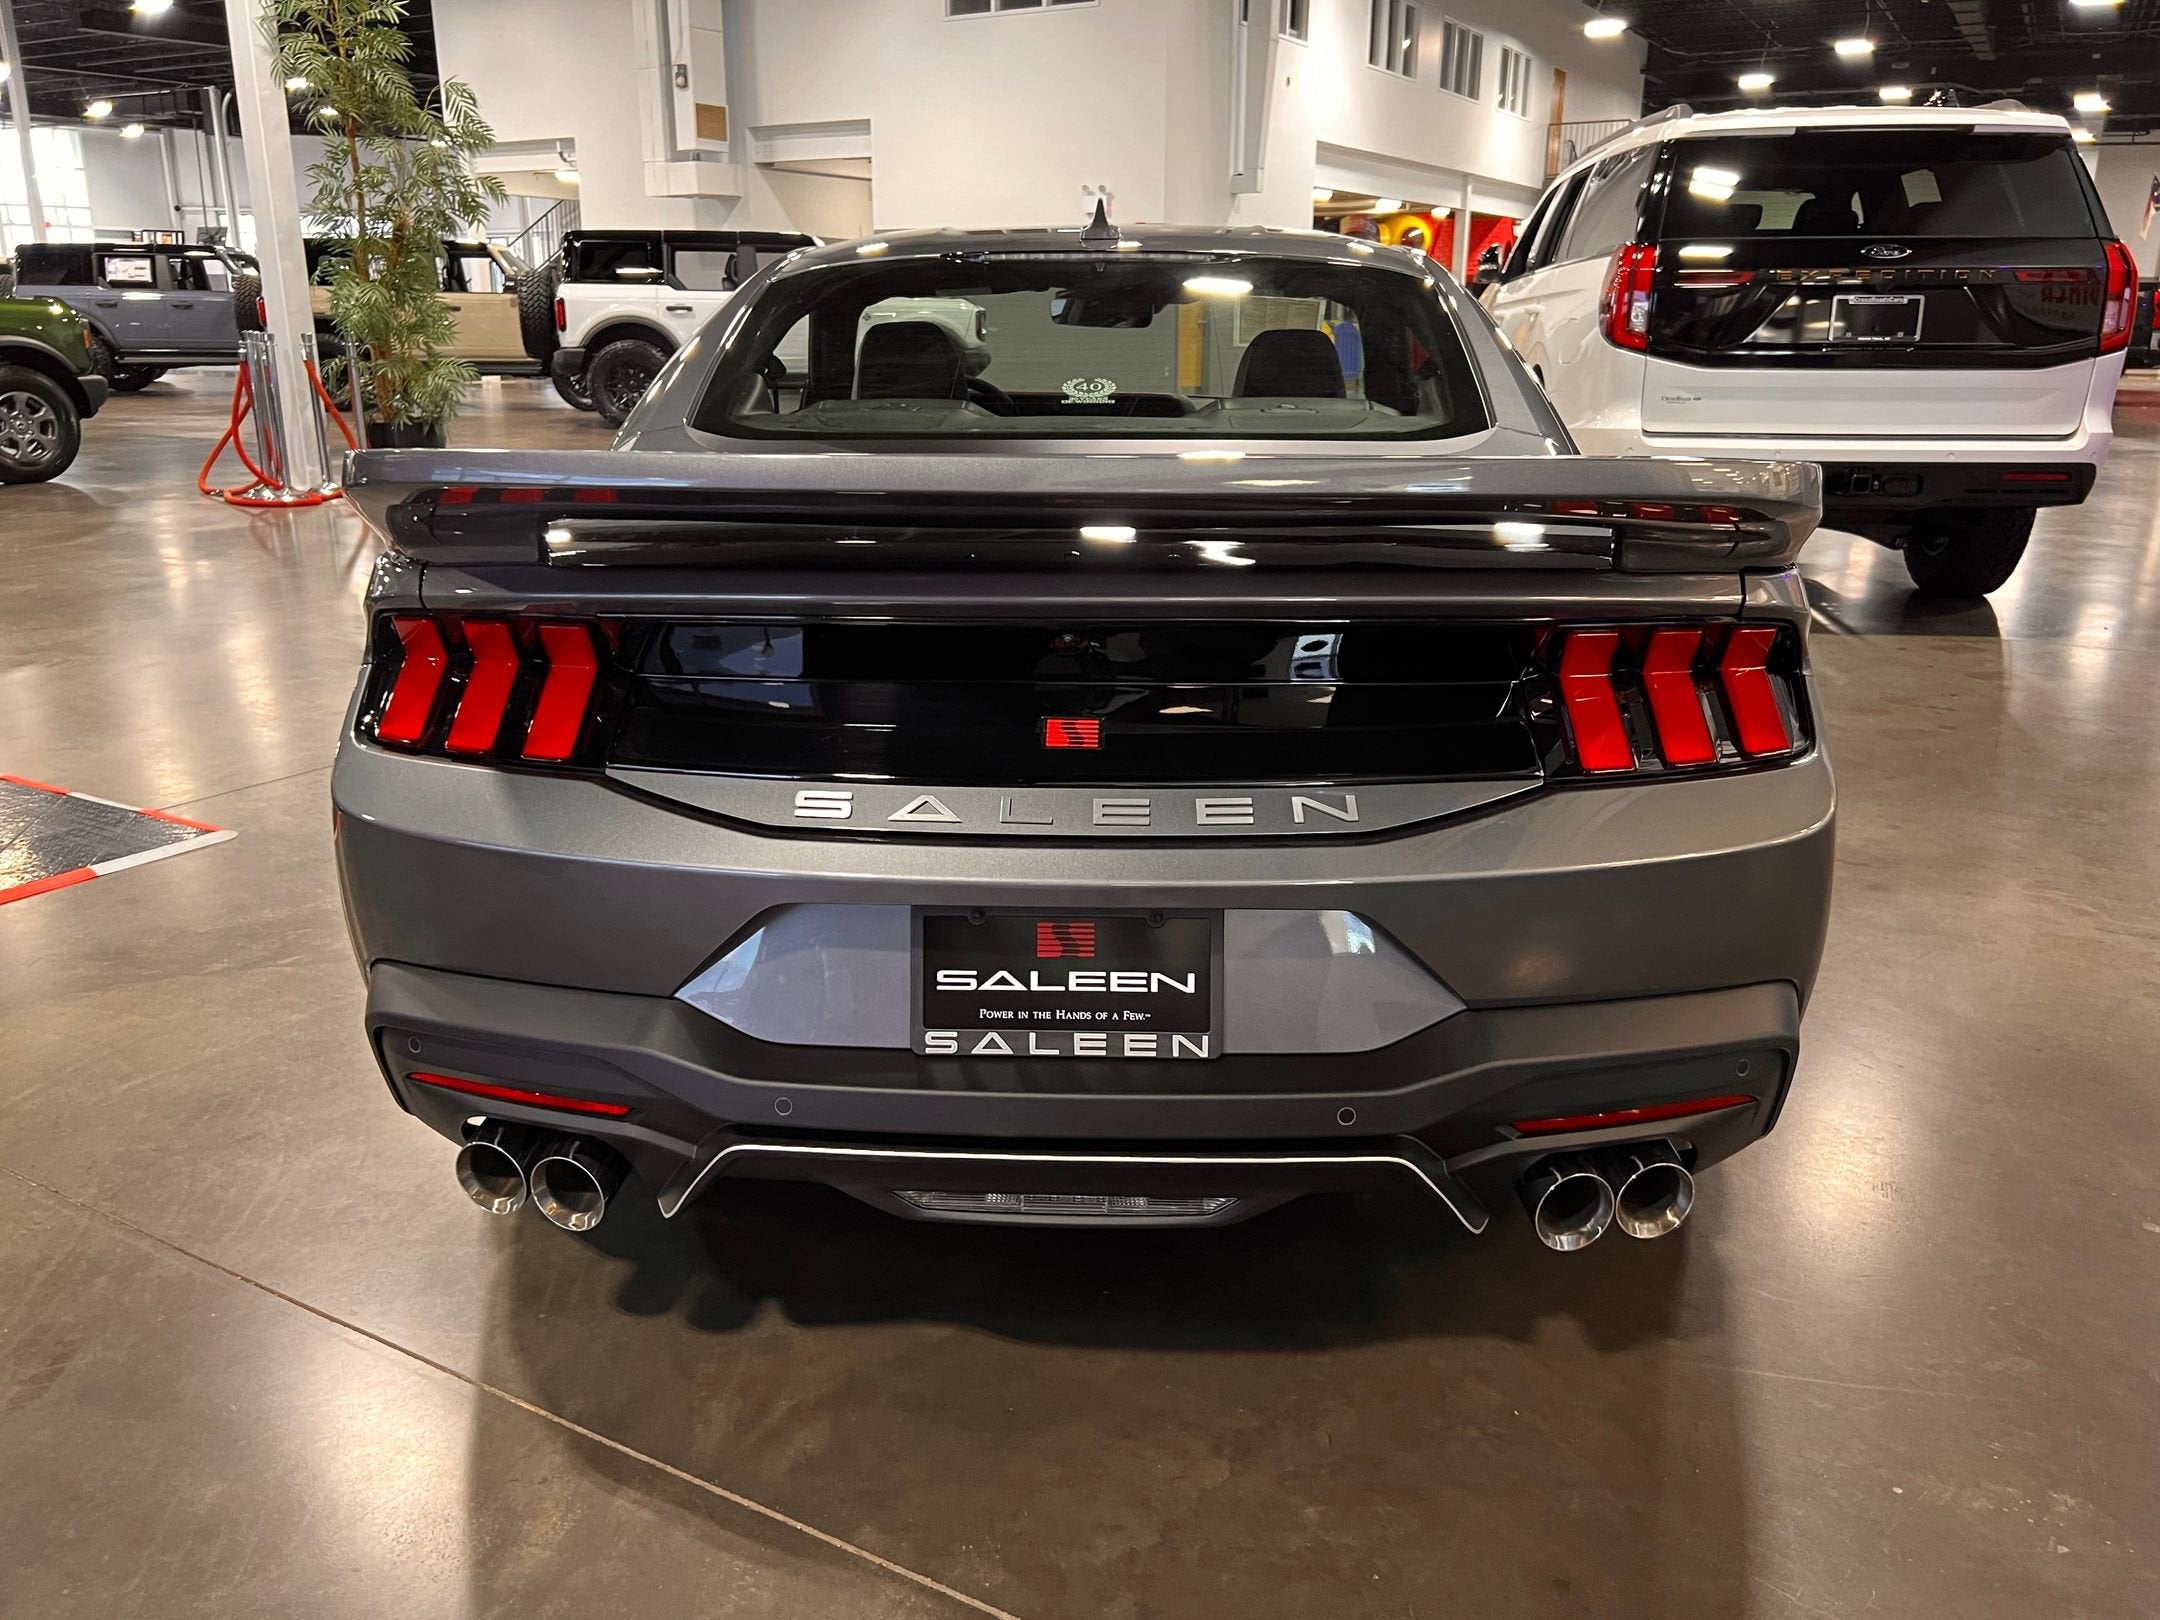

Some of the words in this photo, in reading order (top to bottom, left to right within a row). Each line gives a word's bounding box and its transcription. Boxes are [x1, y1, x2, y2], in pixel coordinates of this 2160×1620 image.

[1776, 269, 1996, 281] EXPEDITION
[1076, 382, 1102, 391] 40
[794, 790, 1359, 826] SALEEN
[936, 969, 1196, 994] SALEEN
[924, 1031, 1209, 1057] SALEEN
